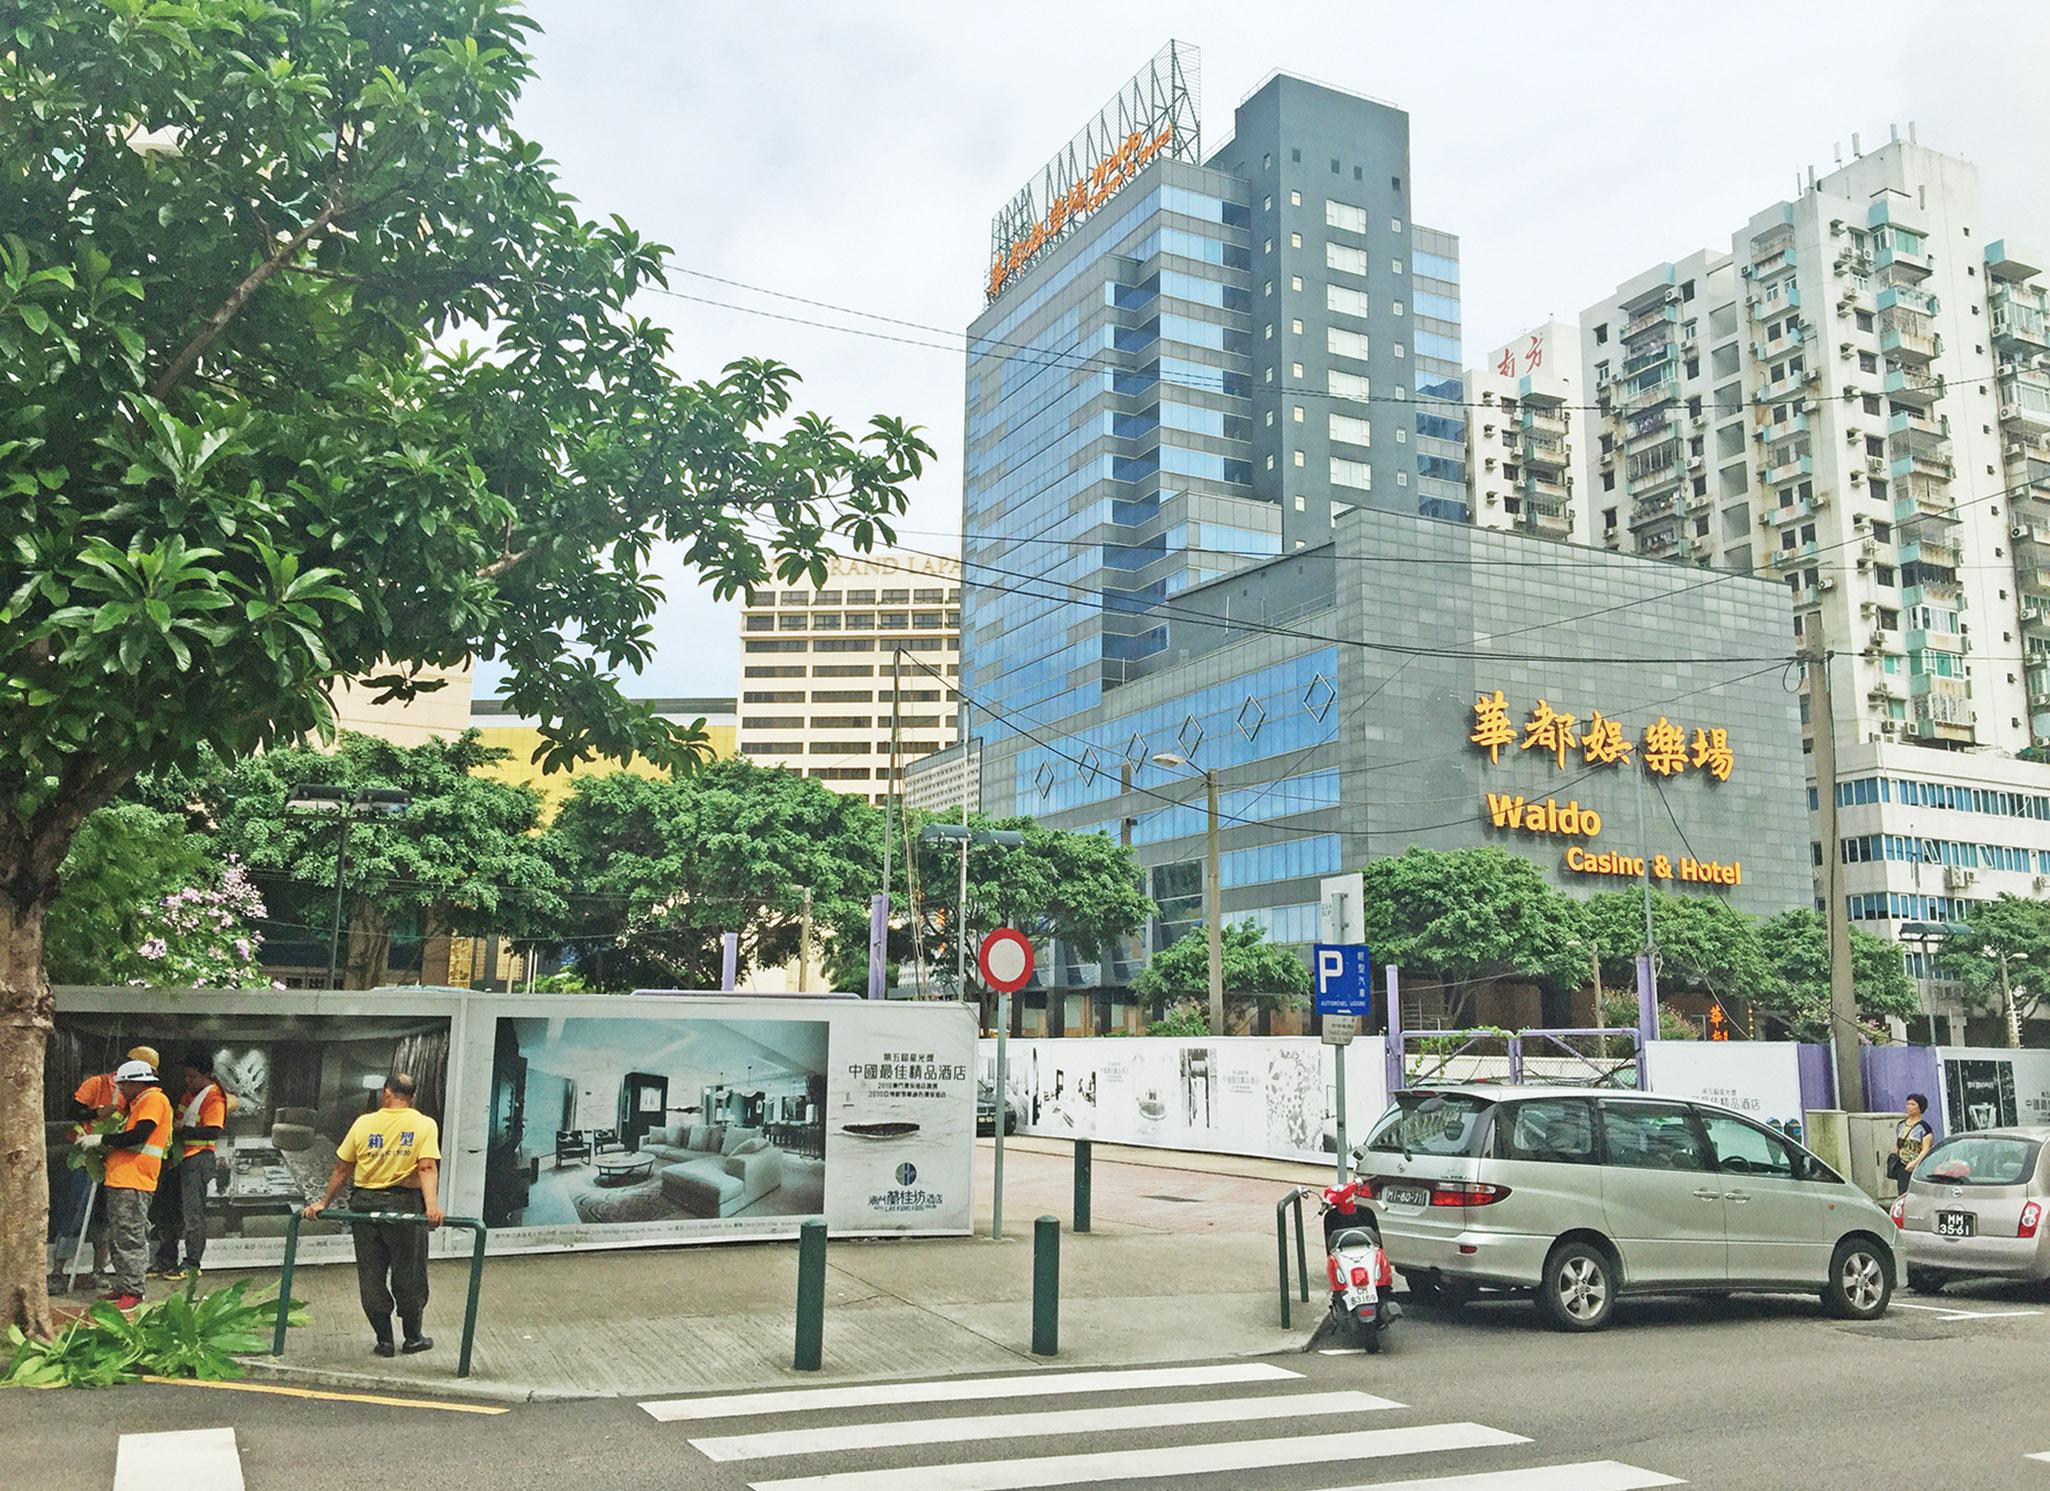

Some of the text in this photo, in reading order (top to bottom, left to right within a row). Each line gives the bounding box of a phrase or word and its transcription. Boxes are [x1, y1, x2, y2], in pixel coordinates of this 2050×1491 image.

[831, 556, 899, 577] RAND
[1469, 689, 1736, 782] 華都娛樂場
[1486, 792, 1602, 837] Waldo
[1653, 854, 1674, 880] &
[1679, 856, 1743, 886] Hotel
[1318, 950, 1344, 994] P
[848, 1063, 967, 1081] 中國最佳精品酒店
[1947, 1214, 1964, 1225] MM
